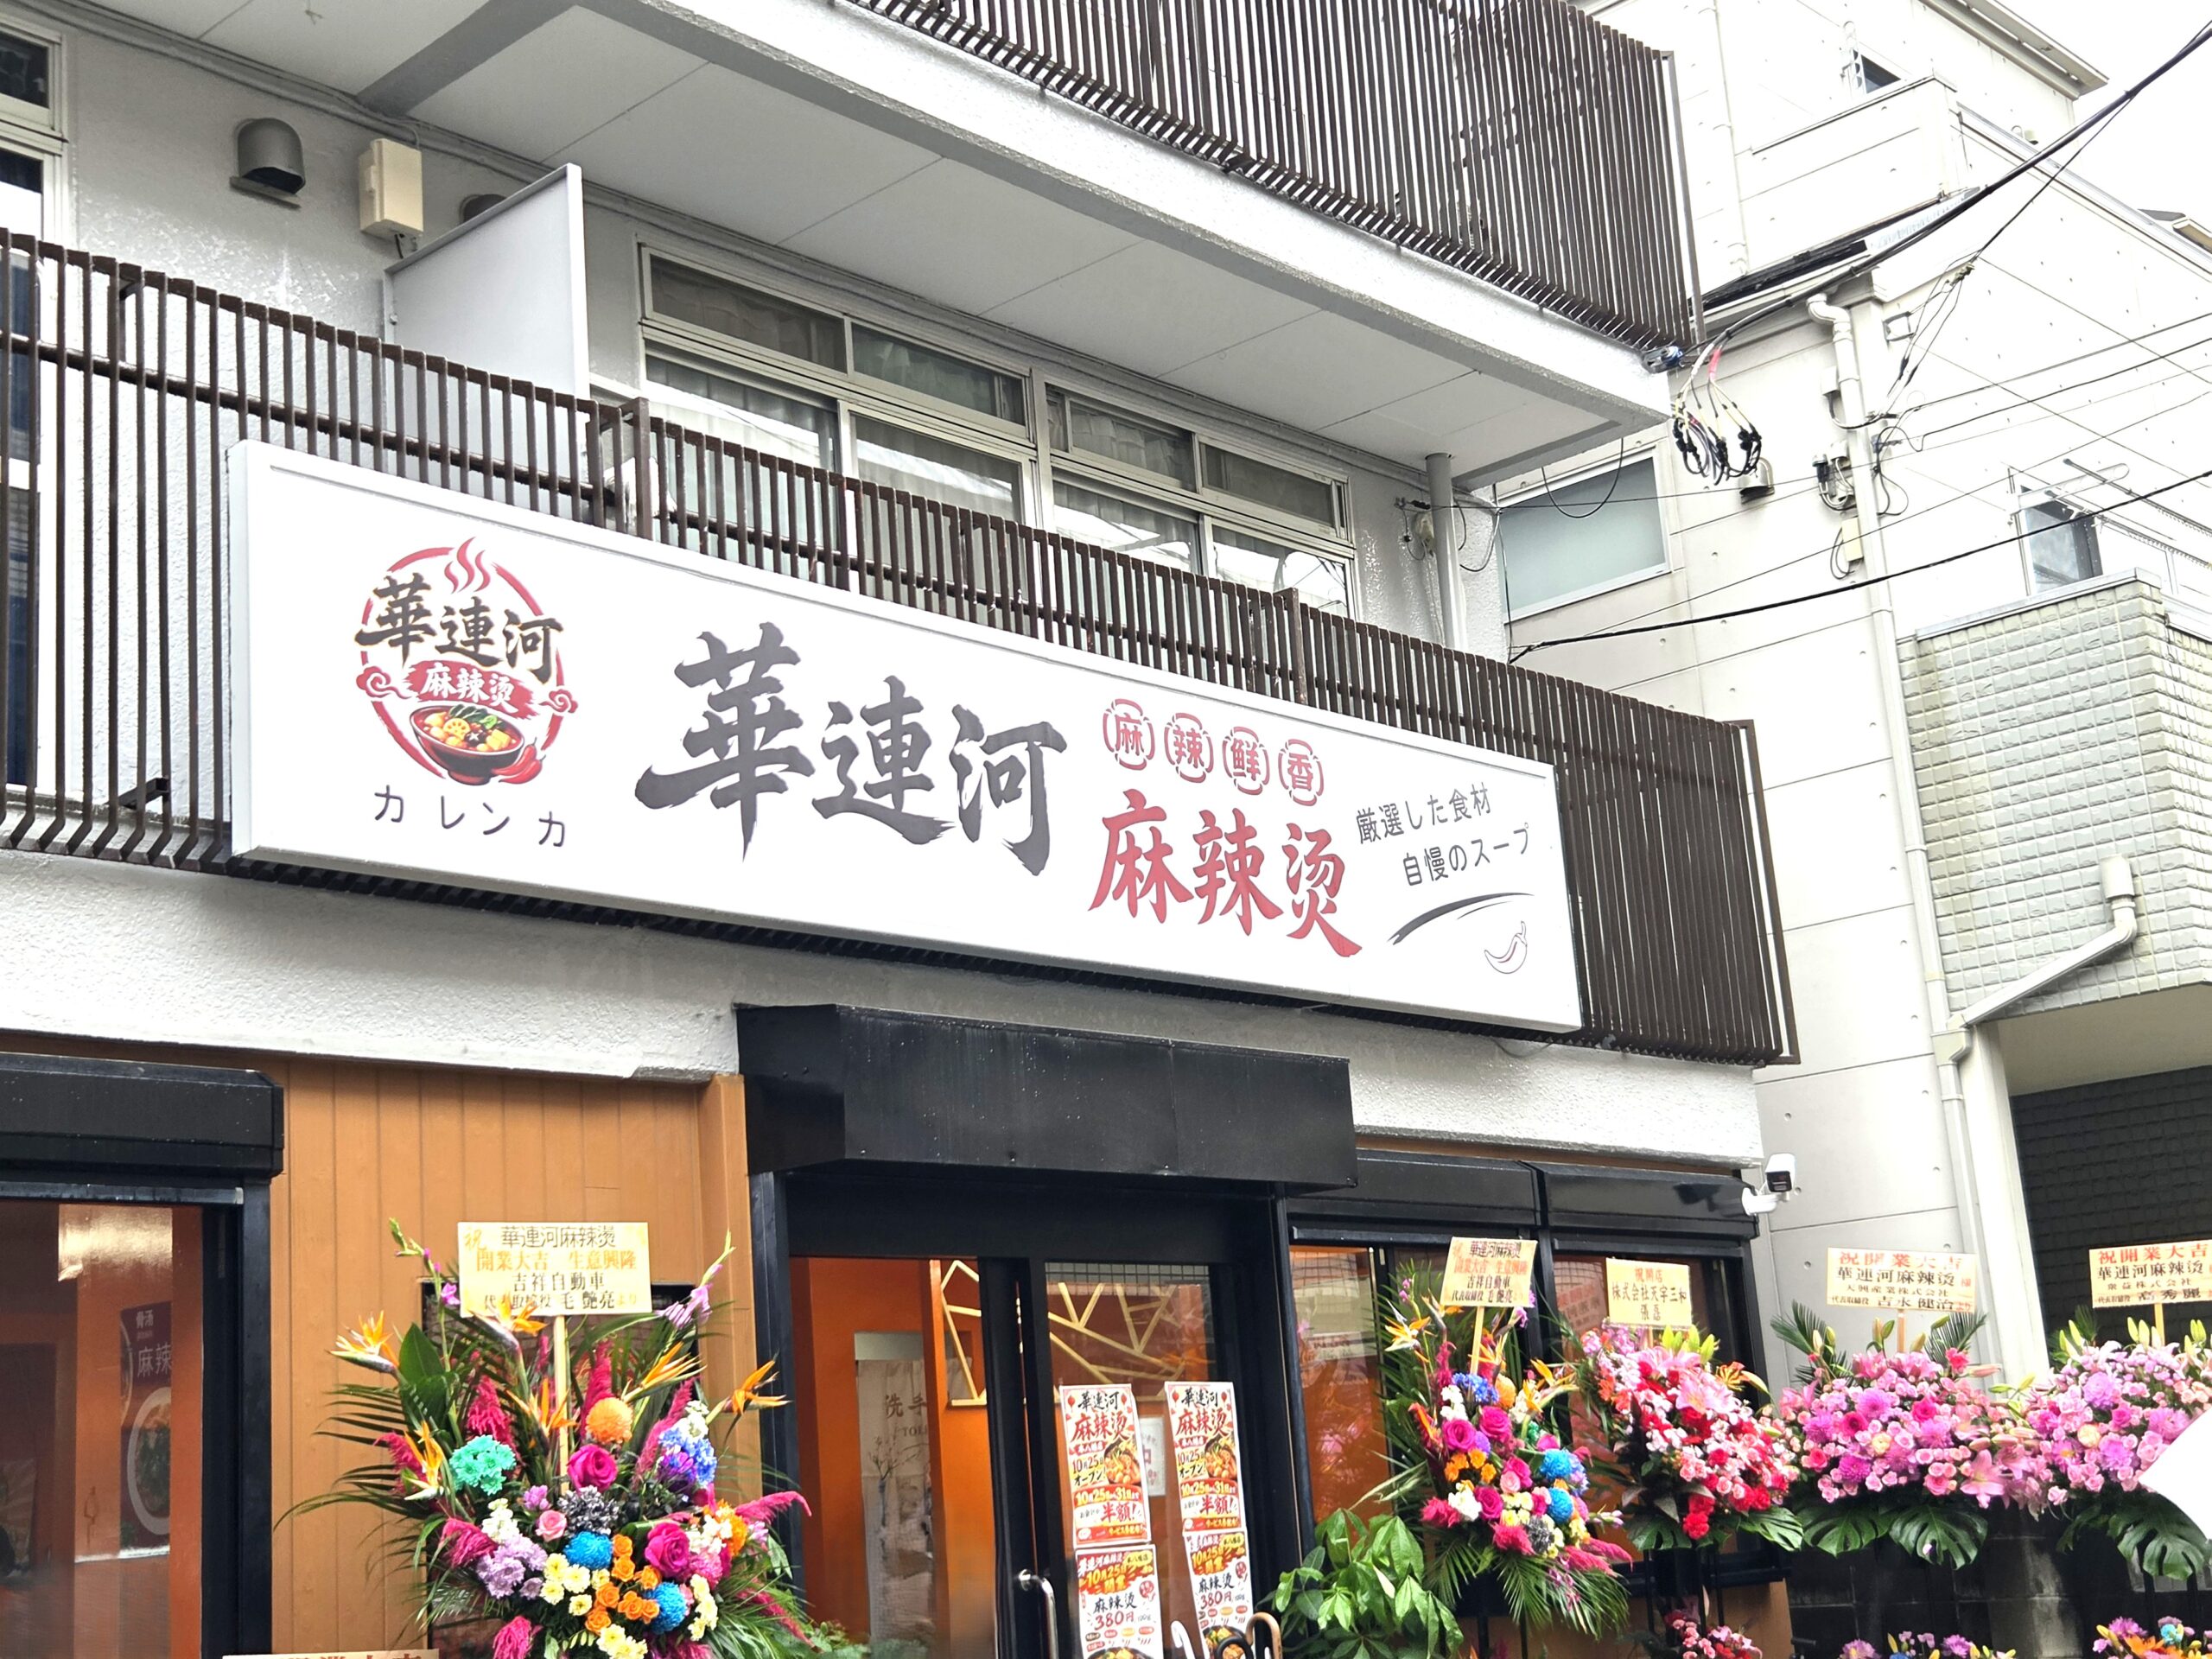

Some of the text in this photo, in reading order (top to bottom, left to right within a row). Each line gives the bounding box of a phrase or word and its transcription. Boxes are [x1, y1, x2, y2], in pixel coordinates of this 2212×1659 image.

[355, 572, 563, 684] 華連河
[419, 662, 516, 716] 麻辣烫
[634, 621, 1067, 876] 華連河
[1115, 713, 1315, 792] 麻辣鮮香
[374, 785, 566, 847] カレンカ
[1357, 782, 1492, 844] 厳選した食材
[1088, 788, 1362, 957] 麻辣烫
[1402, 823, 1530, 887] 自慢のスープ
